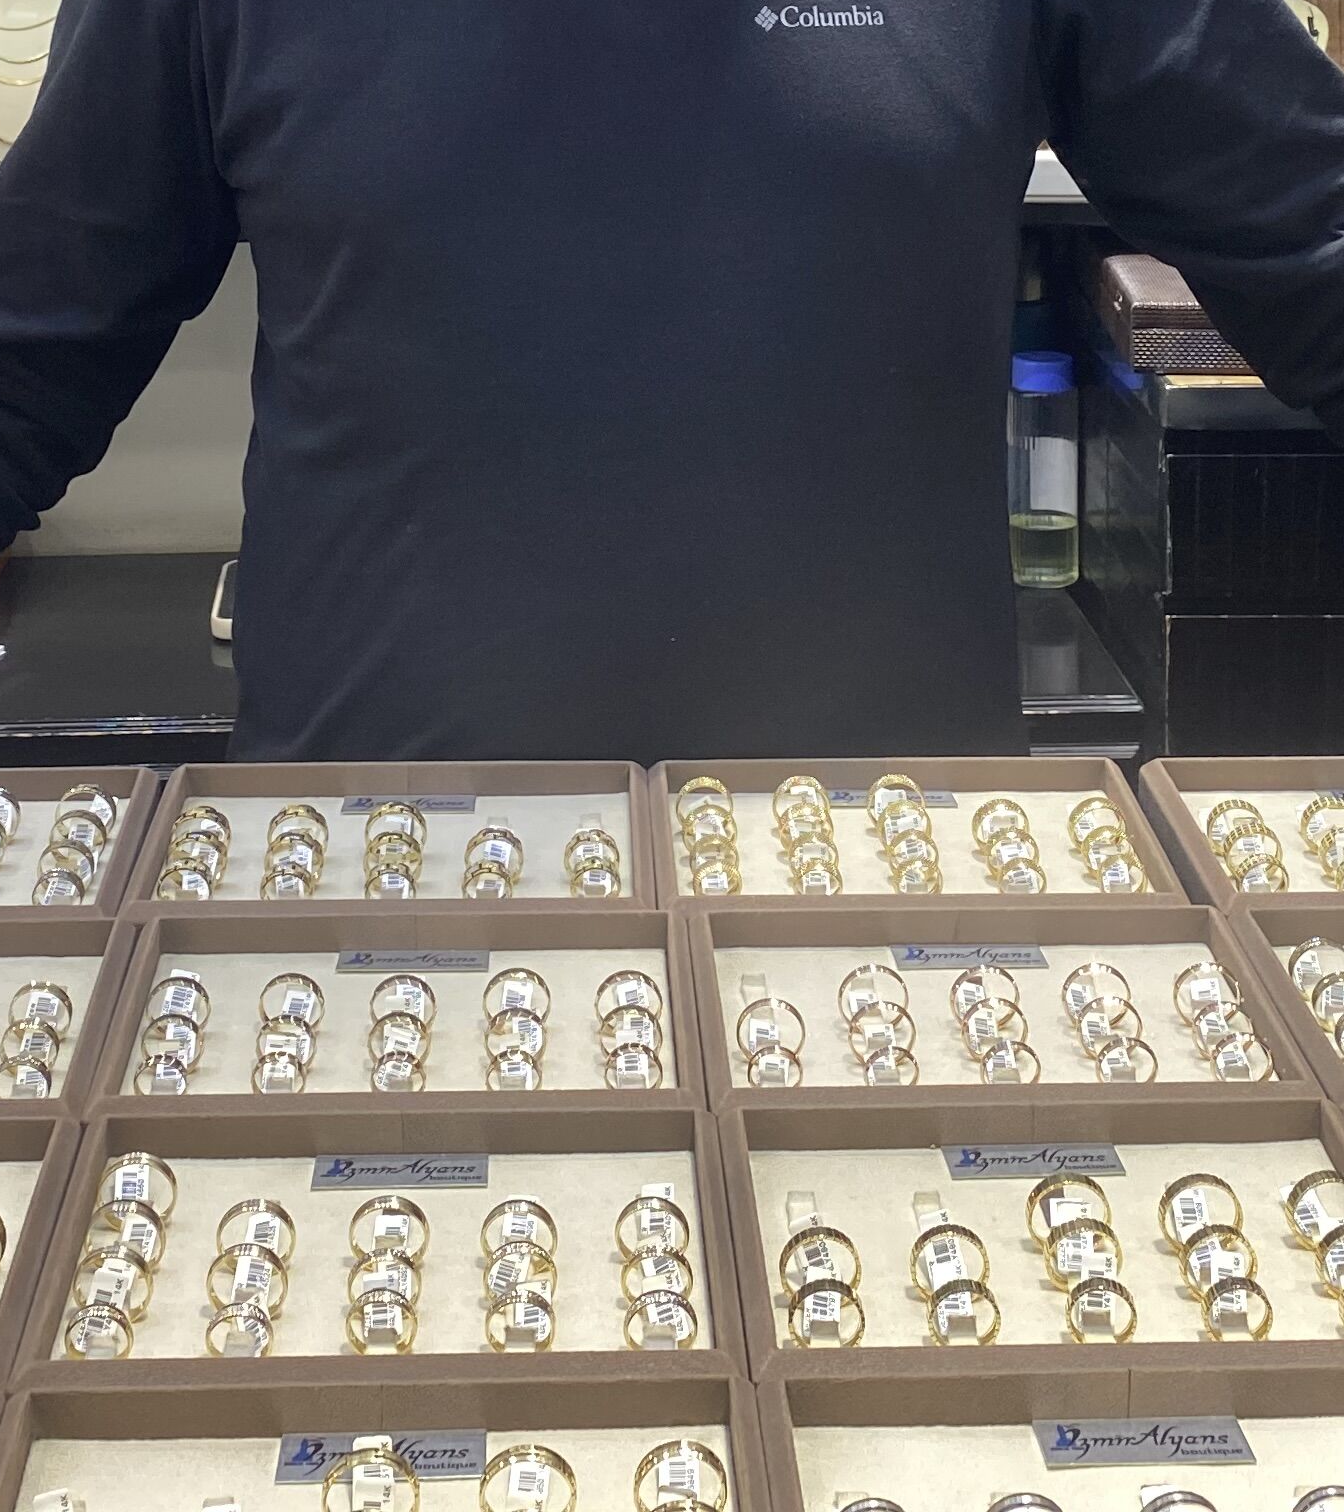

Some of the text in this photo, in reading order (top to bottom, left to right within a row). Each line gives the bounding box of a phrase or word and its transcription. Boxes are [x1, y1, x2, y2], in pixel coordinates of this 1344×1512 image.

[779, 5, 884, 28] Columbia
[1133, 1424, 1229, 1458] Alyans
[382, 1485, 392, 1504] 14K
